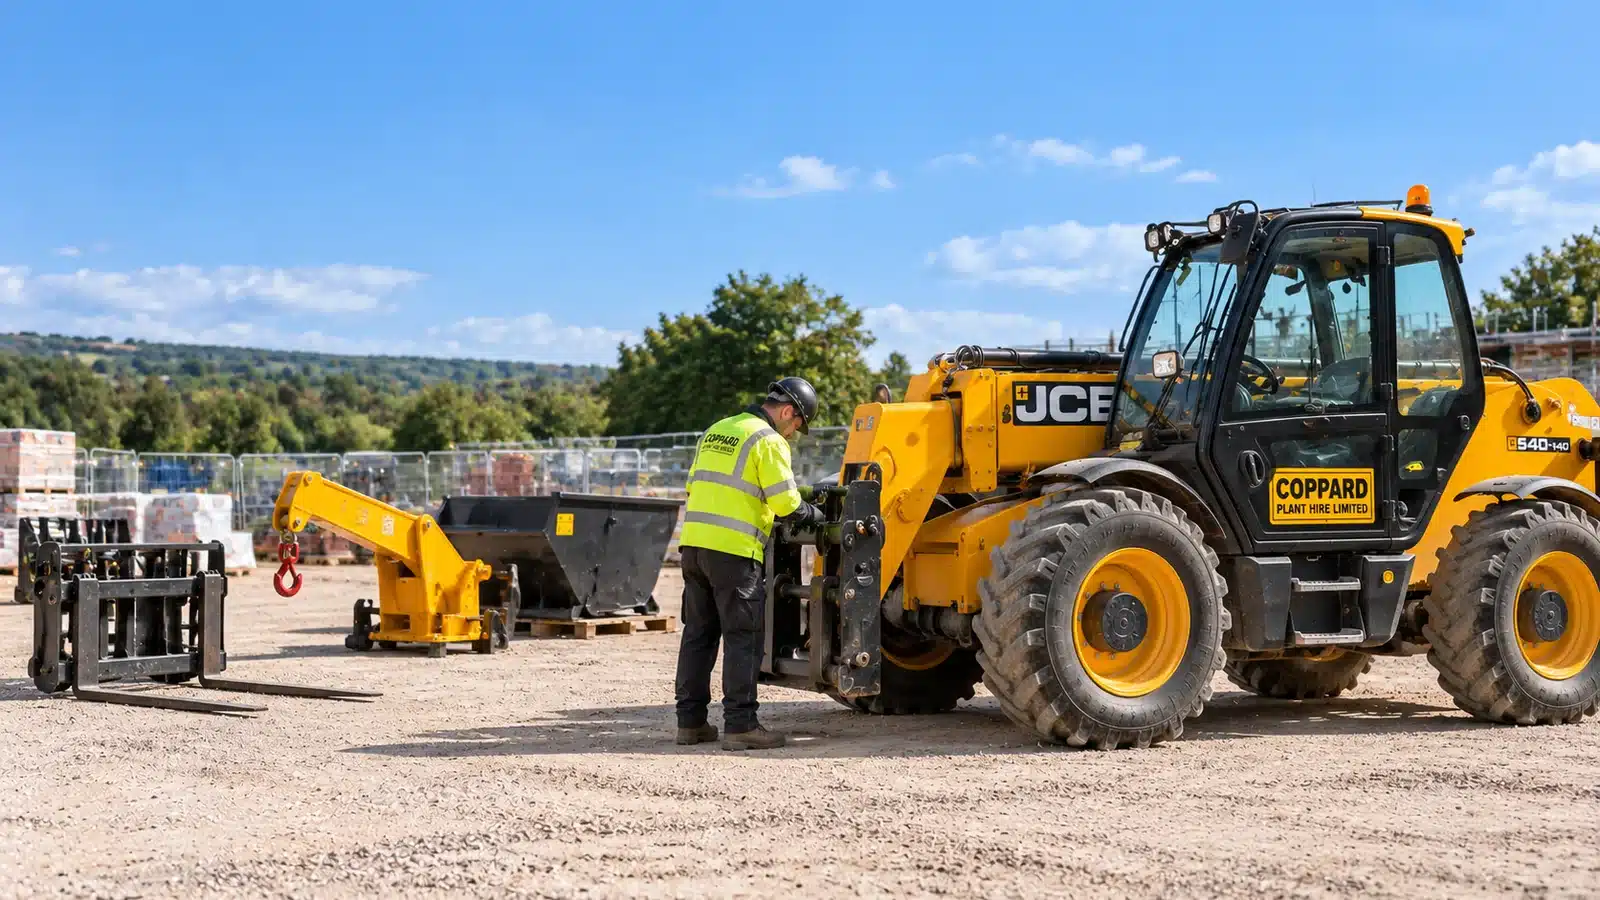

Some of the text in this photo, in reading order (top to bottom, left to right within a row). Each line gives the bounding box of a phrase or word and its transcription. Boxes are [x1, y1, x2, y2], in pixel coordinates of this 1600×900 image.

[704, 433, 740, 447] COPPARD
[1517, 437, 1569, 451] 540-140
[1276, 478, 1368, 499] COPPARD
[1276, 503, 1368, 514] PLANT HIRE LIMITED
